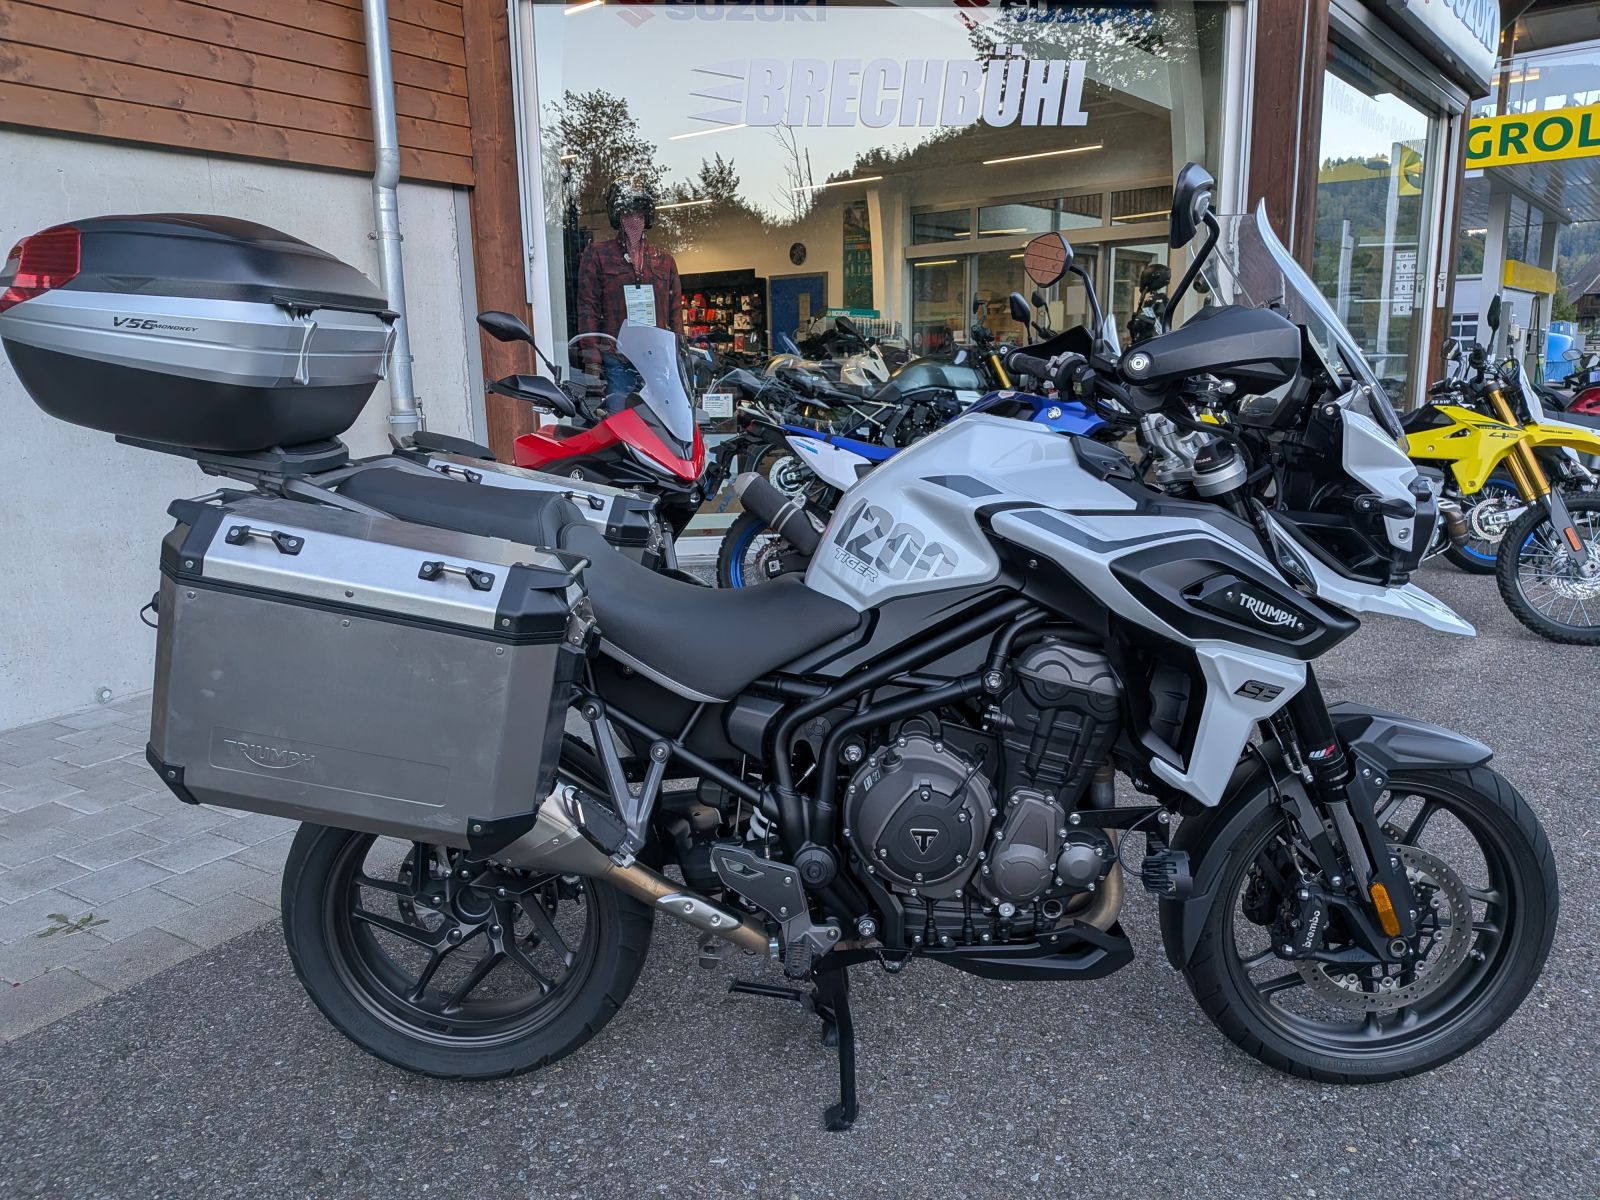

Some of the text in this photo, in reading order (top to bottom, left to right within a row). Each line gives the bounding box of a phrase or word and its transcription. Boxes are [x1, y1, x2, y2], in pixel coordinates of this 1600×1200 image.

[745, 44, 1088, 128] BRECHBÜHL
[113, 316, 199, 332] V56 MONOKEY
[833, 496, 960, 581] 1200
[834, 546, 879, 583] TIGER
[1239, 592, 1298, 628] TRIUMPH
[223, 738, 316, 770] TRIUMPH
[1302, 910, 1321, 948] brembo
